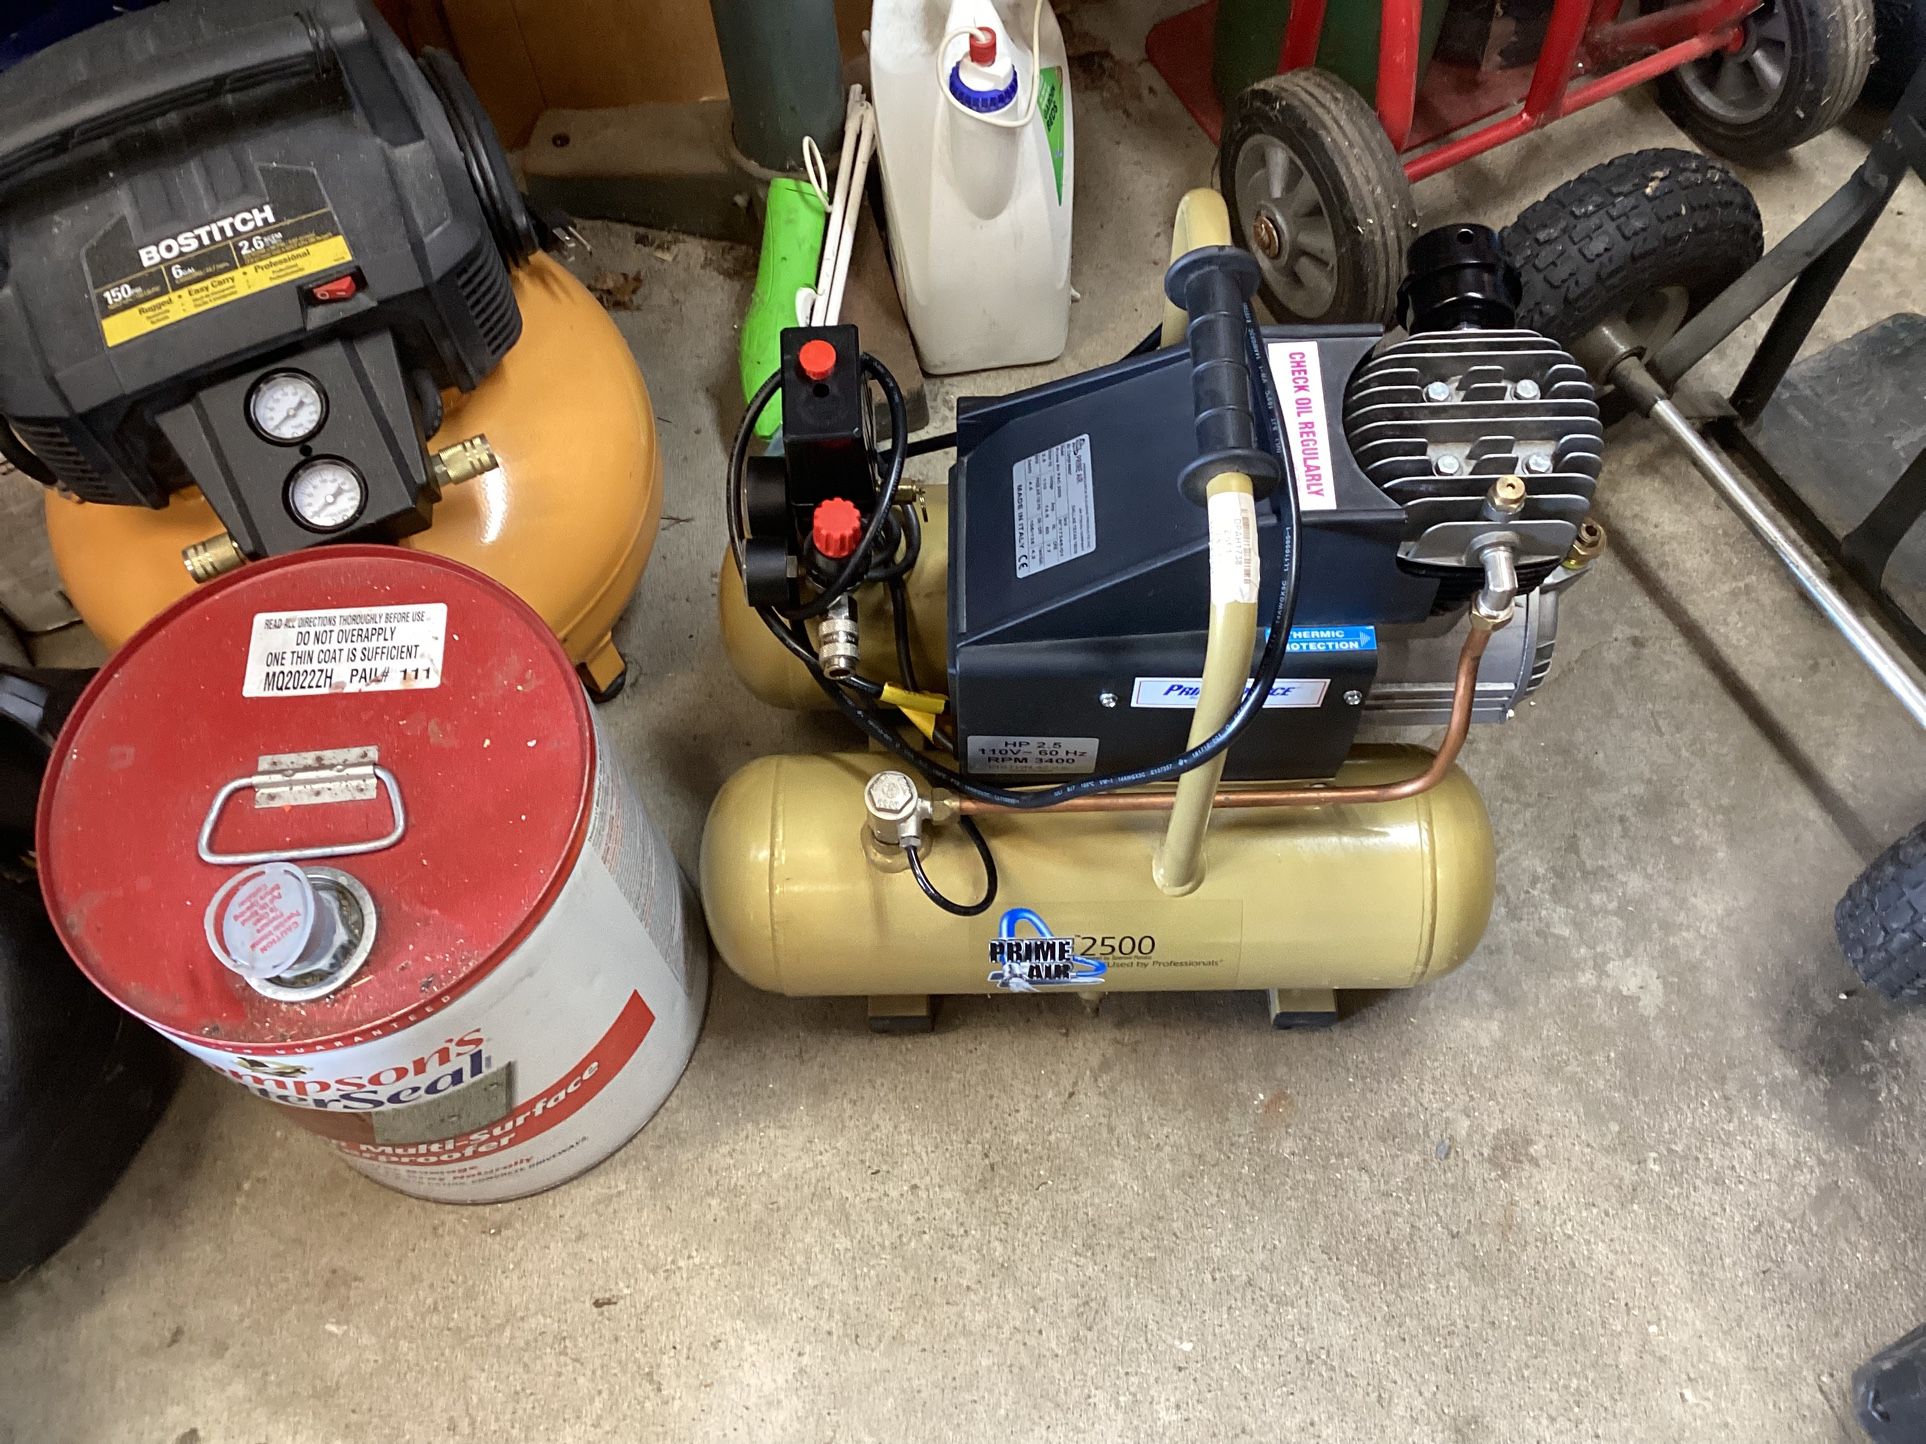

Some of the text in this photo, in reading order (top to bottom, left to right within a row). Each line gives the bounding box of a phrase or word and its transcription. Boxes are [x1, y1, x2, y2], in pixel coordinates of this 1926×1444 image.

[138, 203, 276, 268] BOSTITCH
[238, 235, 264, 256] 2.6
[171, 264, 183, 279] 6
[139, 297, 173, 315] Rugged
[188, 283, 209, 297] Easy
[210, 275, 236, 289] Carry
[254, 249, 311, 273] Professional
[103, 283, 132, 305] 150
[1289, 352, 1325, 497] CHECK OIL REGULARLY
[1018, 512, 1024, 521] IN
[264, 618, 283, 630] READ
[297, 615, 337, 628] DIRECTIONS
[338, 613, 383, 626] THOROUGHLY
[384, 612, 411, 624] BEFORE
[412, 611, 426, 622] USE
[296, 626, 397, 646] DO NOT OVERAPPLY
[1290, 630, 1345, 639] HERMIC
[266, 644, 420, 667] ONE THIN COAT IS SUFFICIENT
[1286, 641, 1360, 651] OTECTION
[263, 668, 334, 692] MQ2022ZH
[1037, 741, 1062, 749] 2.5
[1038, 749, 1059, 757] 60
[988, 756, 1028, 764] RPM
[1081, 935, 1156, 956] 2500
[989, 938, 1074, 980] PRIME AIR
[1137, 960, 1149, 969] by
